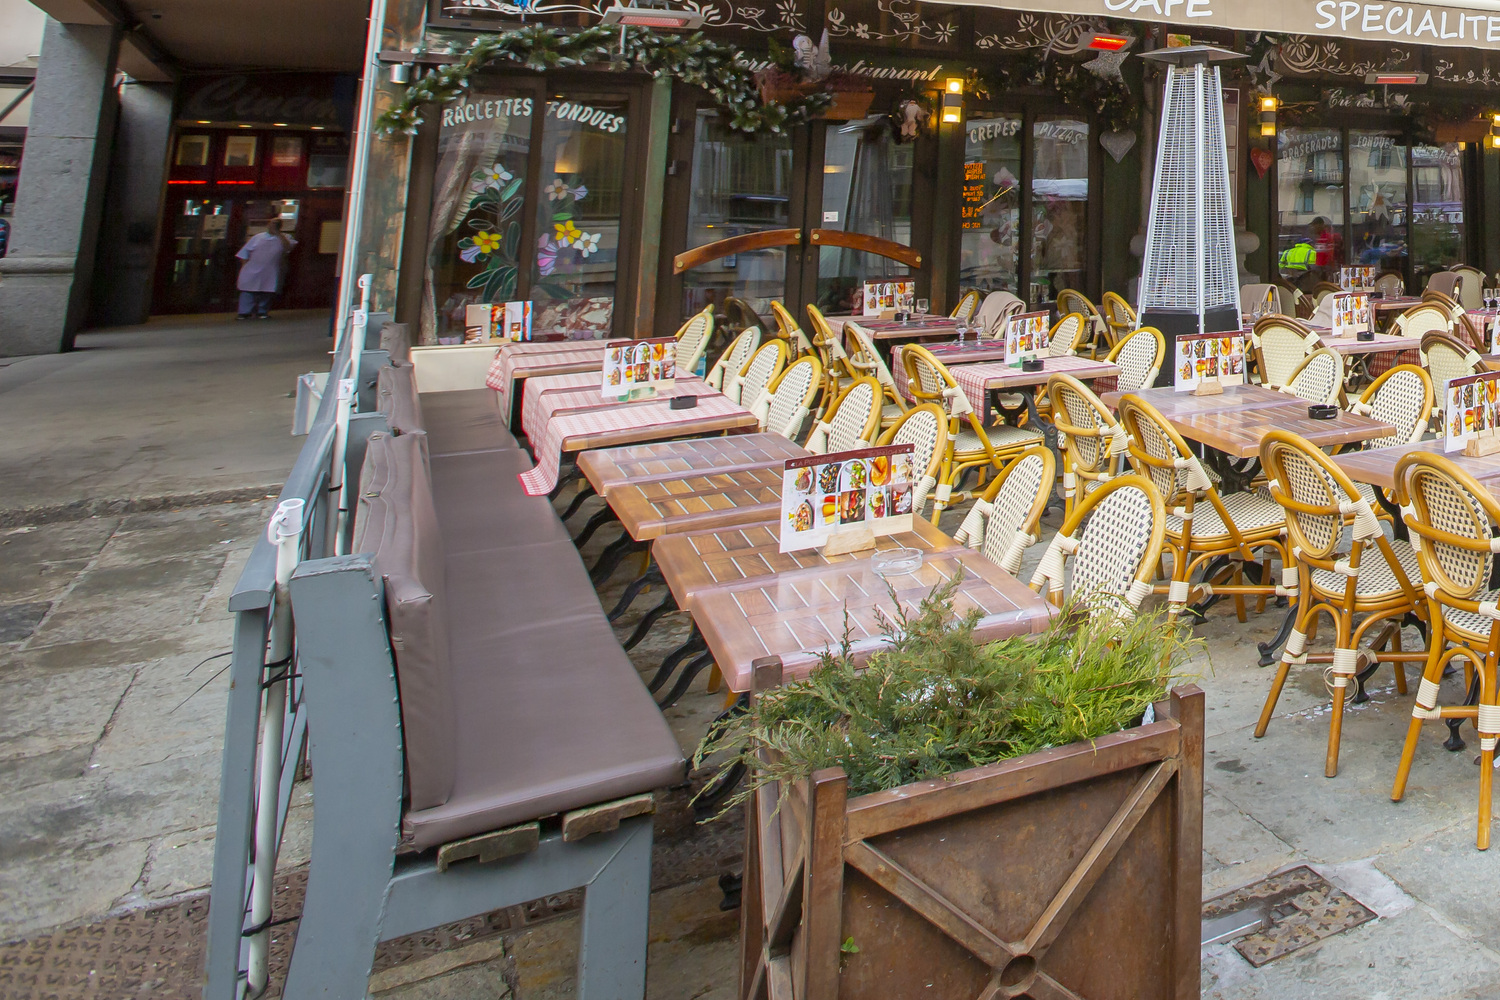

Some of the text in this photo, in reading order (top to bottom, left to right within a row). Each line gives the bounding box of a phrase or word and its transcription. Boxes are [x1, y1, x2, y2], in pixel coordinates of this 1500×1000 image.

[443, 97, 533, 127] RACLETTES
[547, 101, 625, 133] FONDUES
[970, 121, 1018, 144] CREPES
[1039, 123, 1083, 145] PIZZAS
